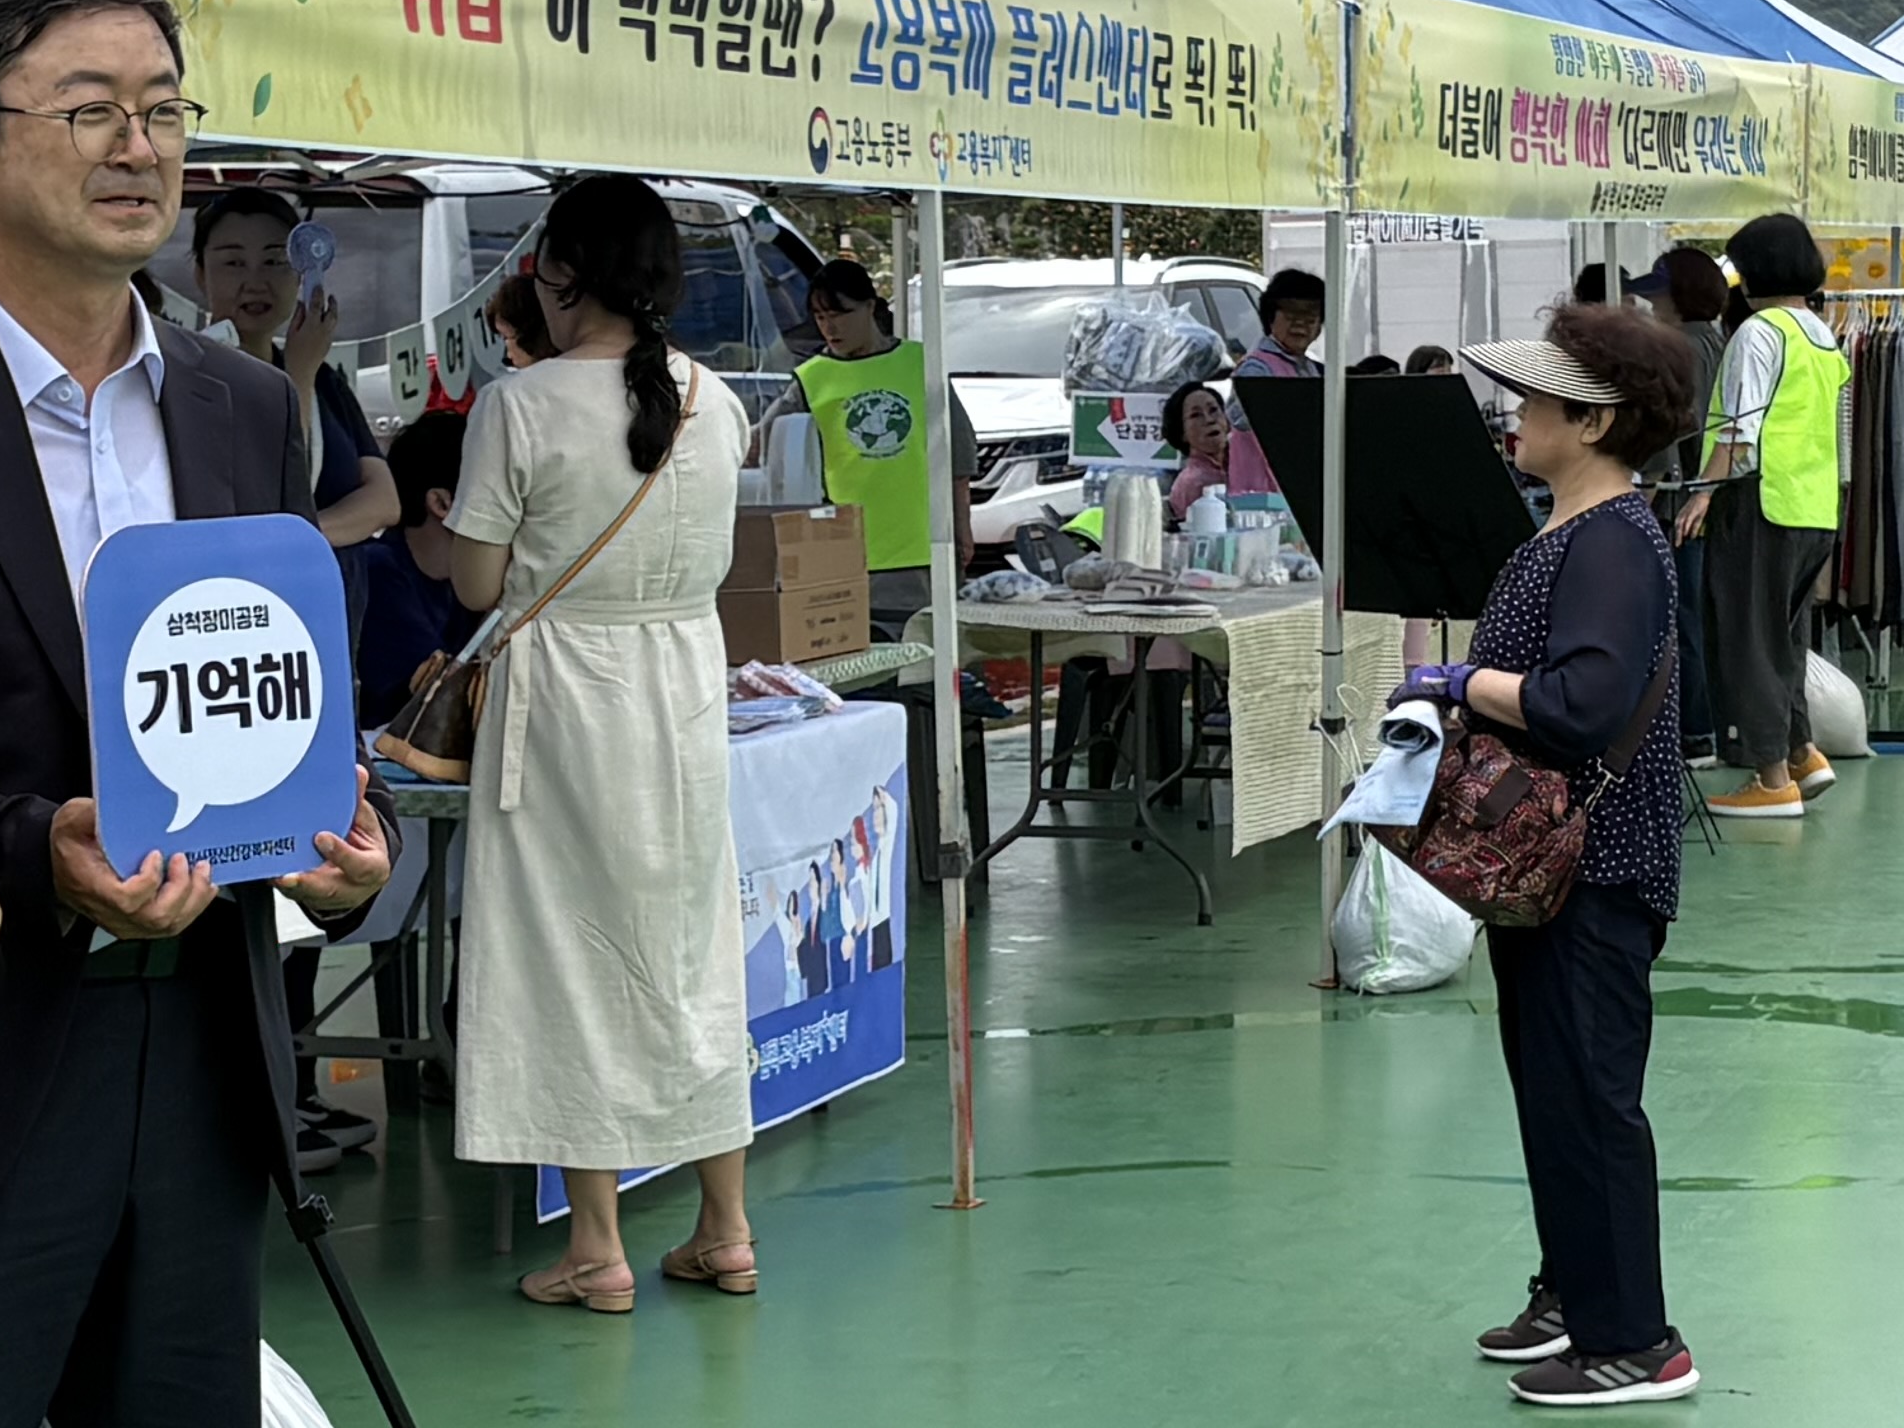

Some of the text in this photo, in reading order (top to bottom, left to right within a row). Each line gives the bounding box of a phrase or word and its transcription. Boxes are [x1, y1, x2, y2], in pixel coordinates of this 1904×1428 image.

[1185, 36, 1216, 128] 똑!
[1226, 43, 1257, 132] 똑!
[835, 116, 912, 168] 고용노동부
[1438, 81, 1503, 161] 더불어
[1510, 86, 1570, 167] 행복한
[1693, 114, 1742, 176] 우리는
[166, 604, 270, 637] 삼척장미공원
[137, 651, 311, 734] 기억해
